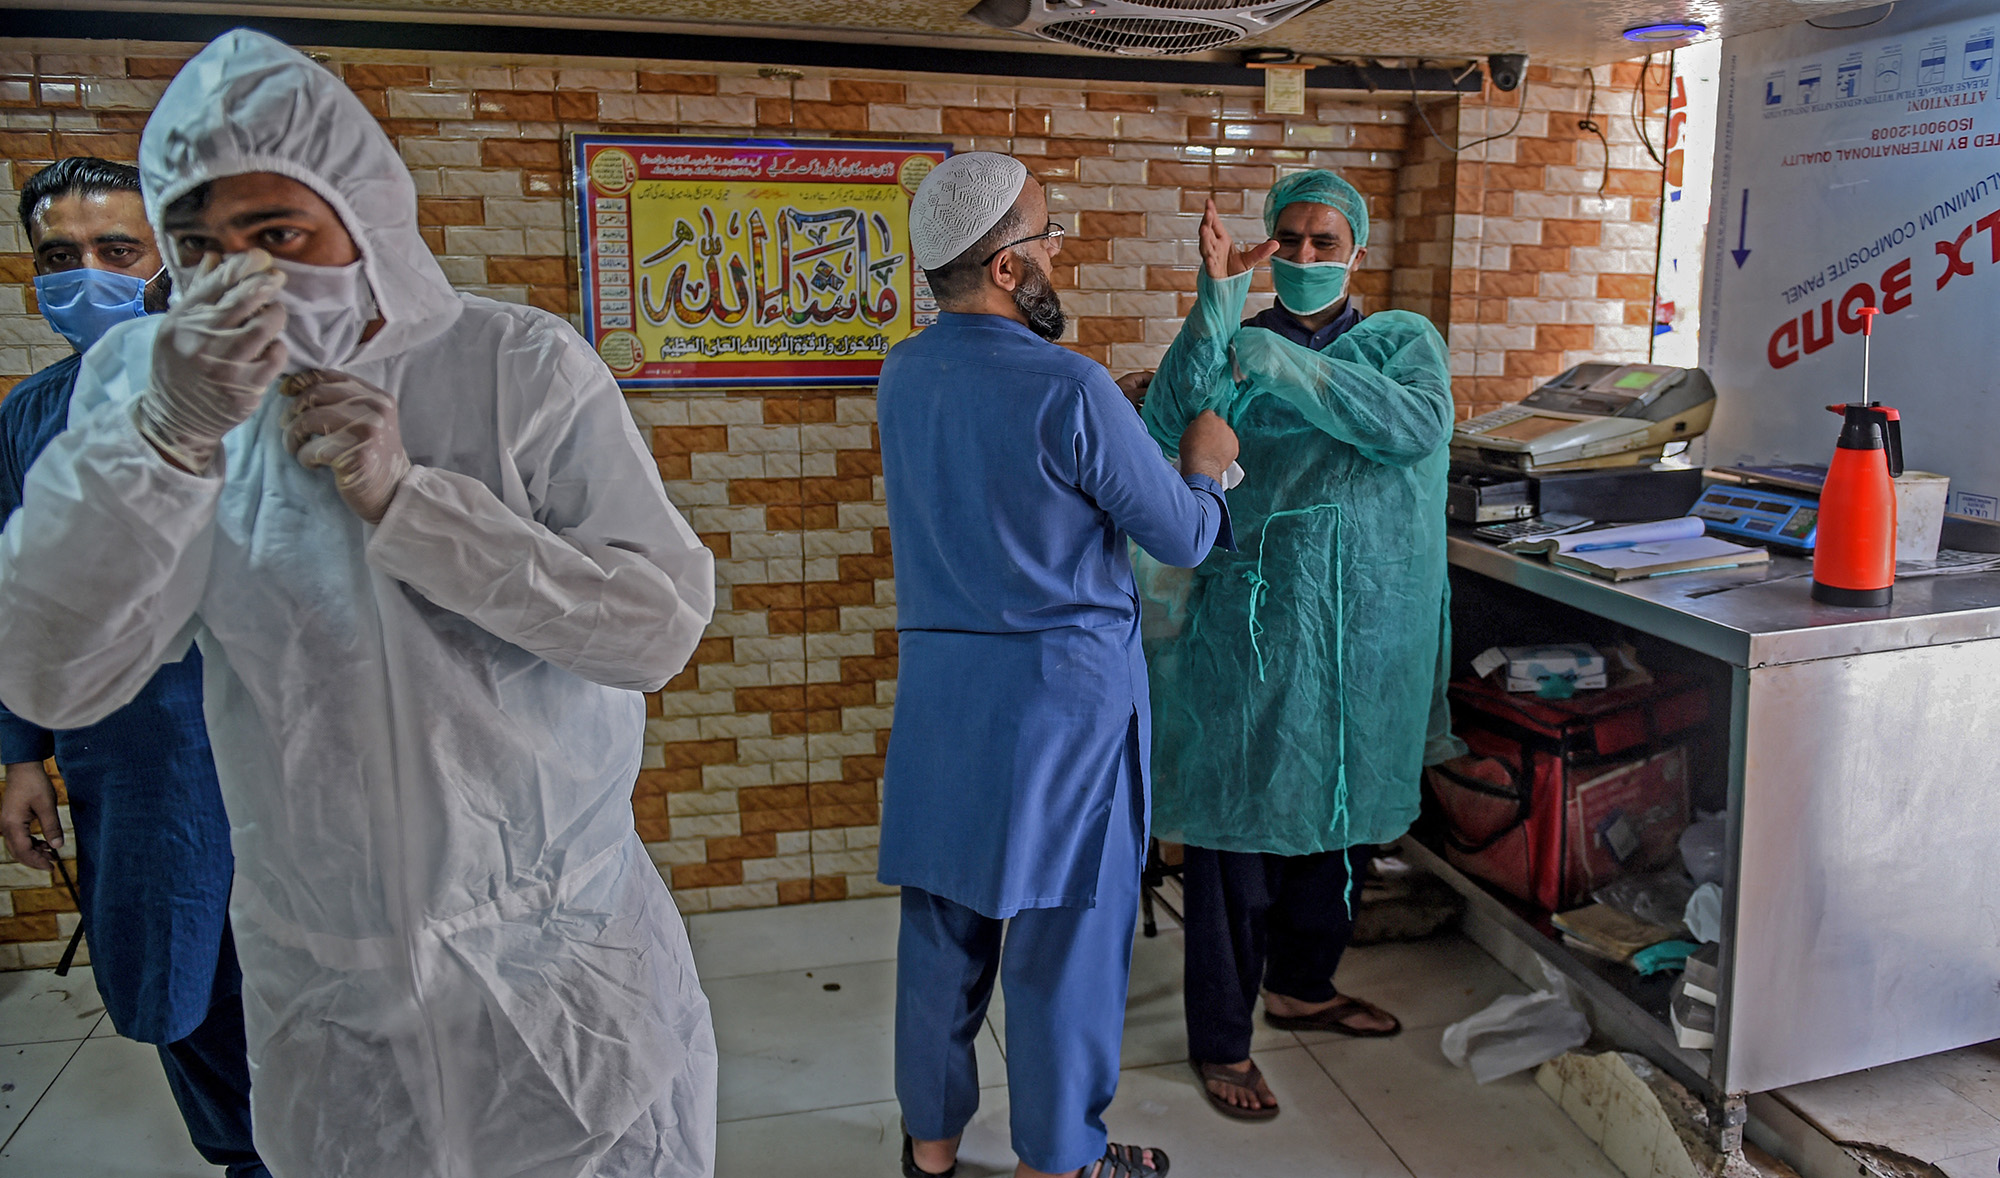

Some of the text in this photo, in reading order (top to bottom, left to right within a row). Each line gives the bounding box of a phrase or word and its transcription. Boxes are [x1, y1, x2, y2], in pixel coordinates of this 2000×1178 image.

[1918, 83, 1954, 97] REMOVE
[1955, 78, 1990, 93] PLEASE
[1863, 92, 1895, 105] WITHIN
[1895, 88, 1917, 101] FILM
[1906, 90, 1989, 112] ATTENTION!
[1871, 117, 1974, 141] ISO9001:2008
[1835, 138, 1944, 161] INTERNATIONAL
[1947, 136, 1969, 151] BY
[1780, 151, 1833, 167] QUALITY
[1826, 221, 1917, 281] COMPOSITE
[1781, 271, 1826, 305] PANEL
[1963, 507, 1988, 518] UKAS
